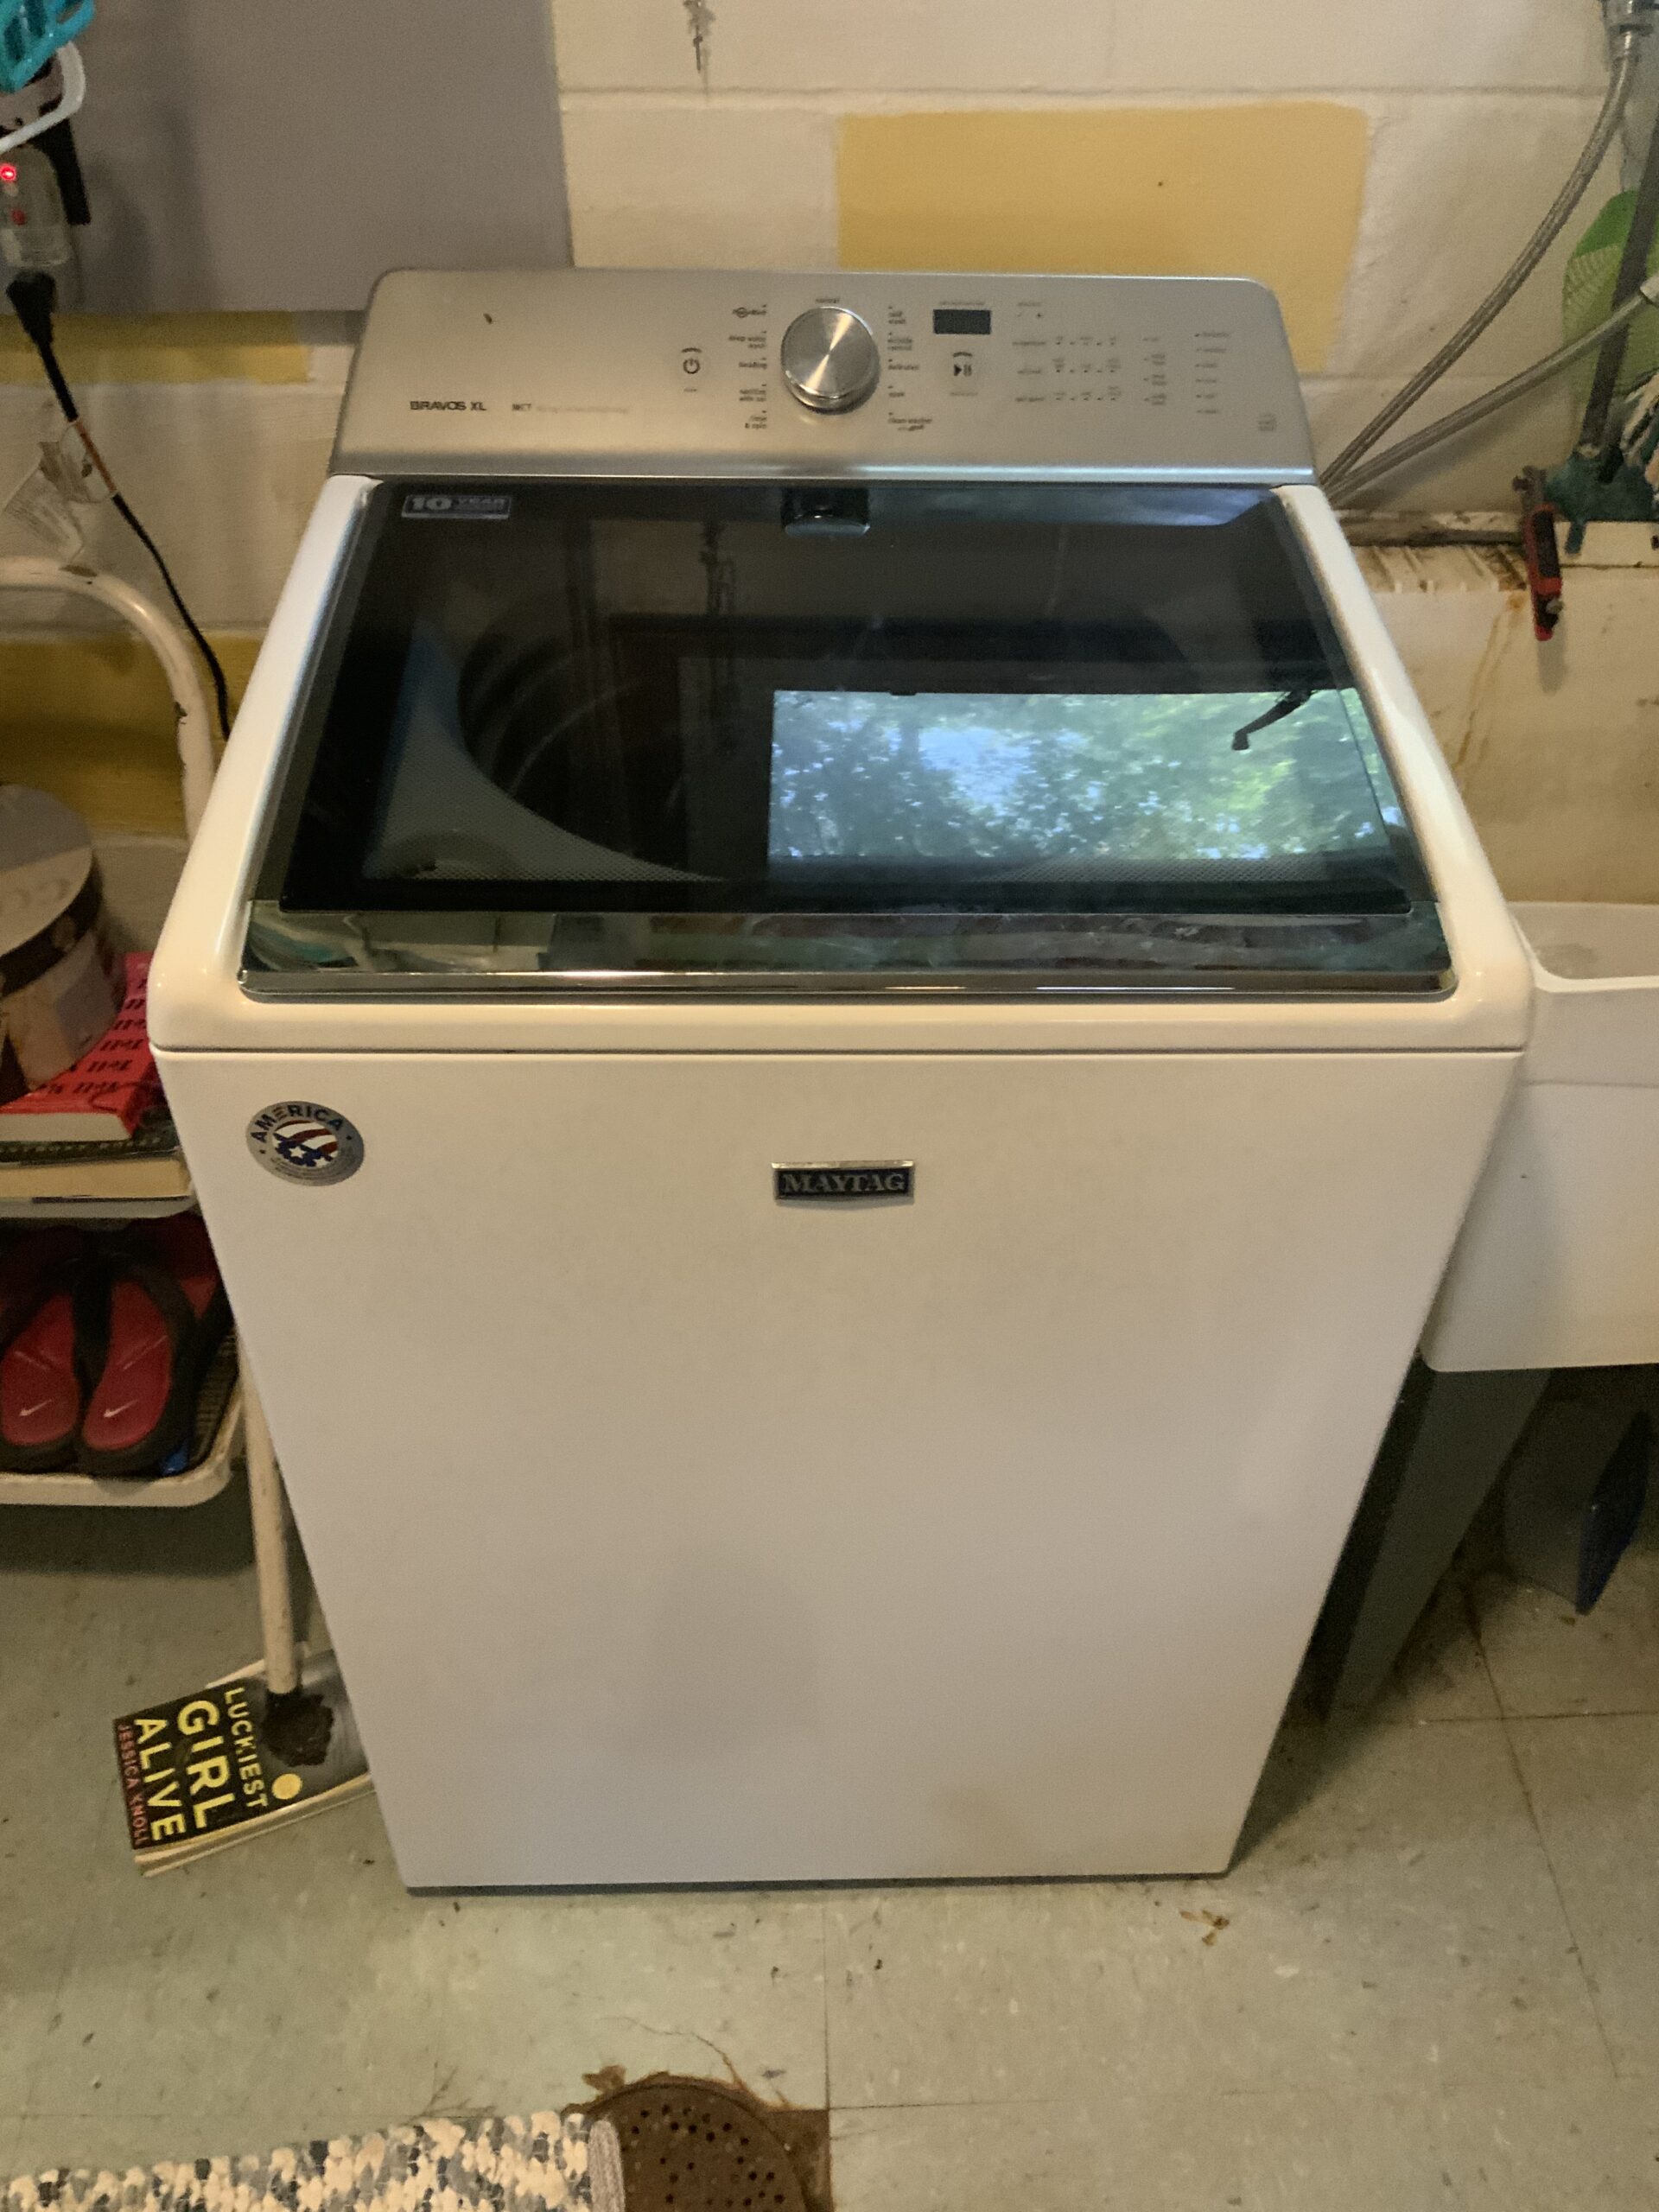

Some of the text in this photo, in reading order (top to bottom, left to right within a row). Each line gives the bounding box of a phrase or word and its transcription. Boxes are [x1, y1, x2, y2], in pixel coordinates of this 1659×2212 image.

[410, 400, 487, 410] BRAVOS XL
[412, 497, 453, 511] 10
[250, 1103, 345, 1144] AMERICA
[782, 1173, 906, 1193] MAYTAG
[117, 1724, 150, 1847] JESSICA KNOLL
[134, 1718, 187, 1841] ALIVE
[177, 1700, 236, 1829] GIRL
[223, 1687, 269, 1808] LUCKIEST
